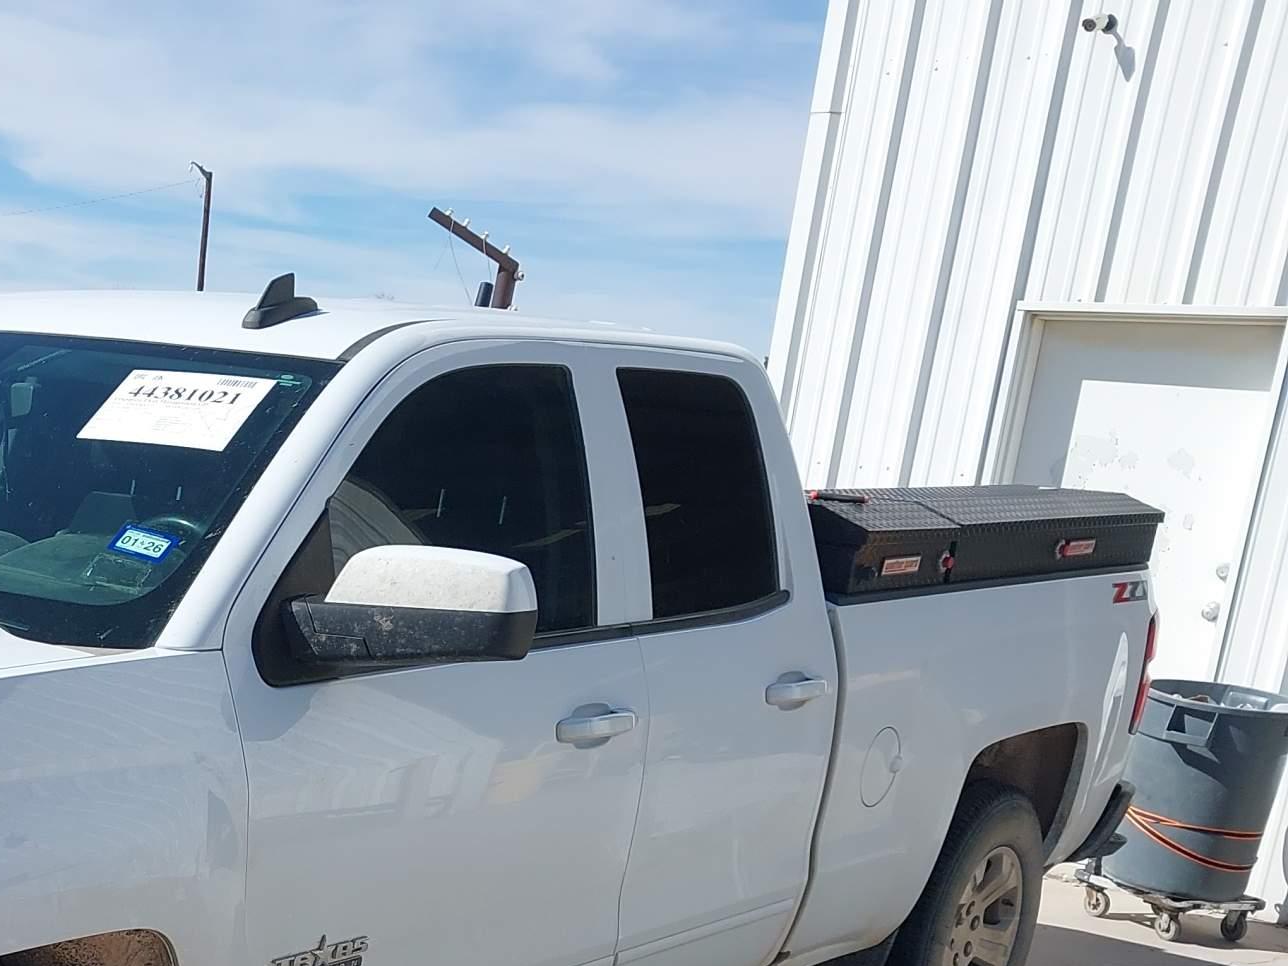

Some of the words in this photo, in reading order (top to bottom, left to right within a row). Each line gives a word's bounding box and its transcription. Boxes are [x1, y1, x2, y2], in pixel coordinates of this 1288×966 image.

[128, 384, 243, 405] 44381021
[121, 535, 139, 547] 01
[143, 541, 164, 553] 26
